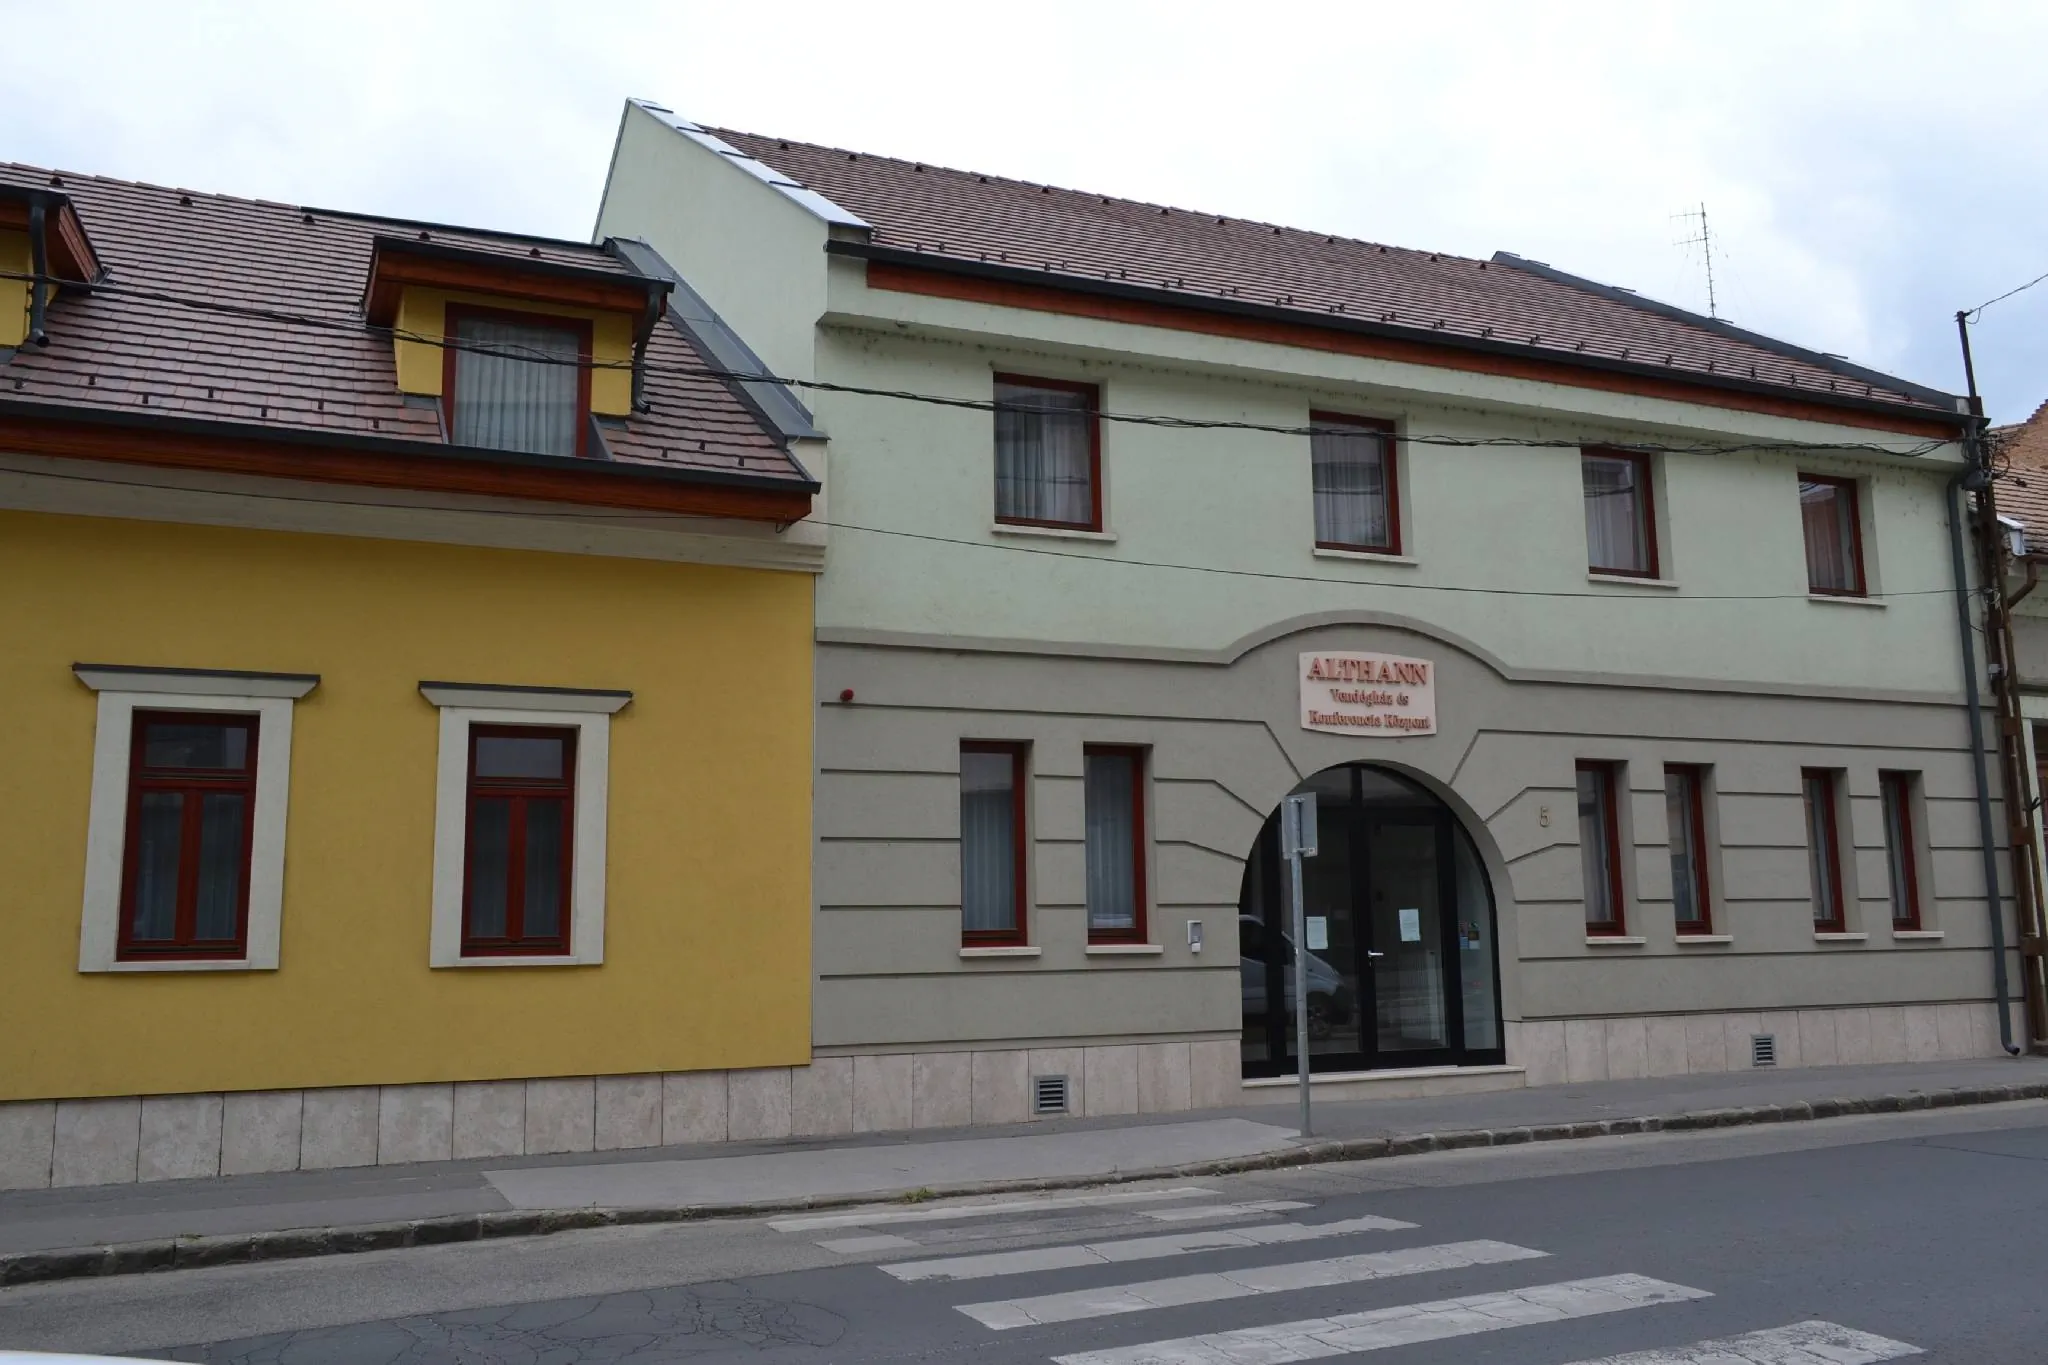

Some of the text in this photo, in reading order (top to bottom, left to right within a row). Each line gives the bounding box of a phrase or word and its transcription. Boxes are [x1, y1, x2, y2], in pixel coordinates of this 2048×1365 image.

[1307, 656, 1429, 686] ALTHANN
[1308, 709, 1431, 732] Konferencia Központ
